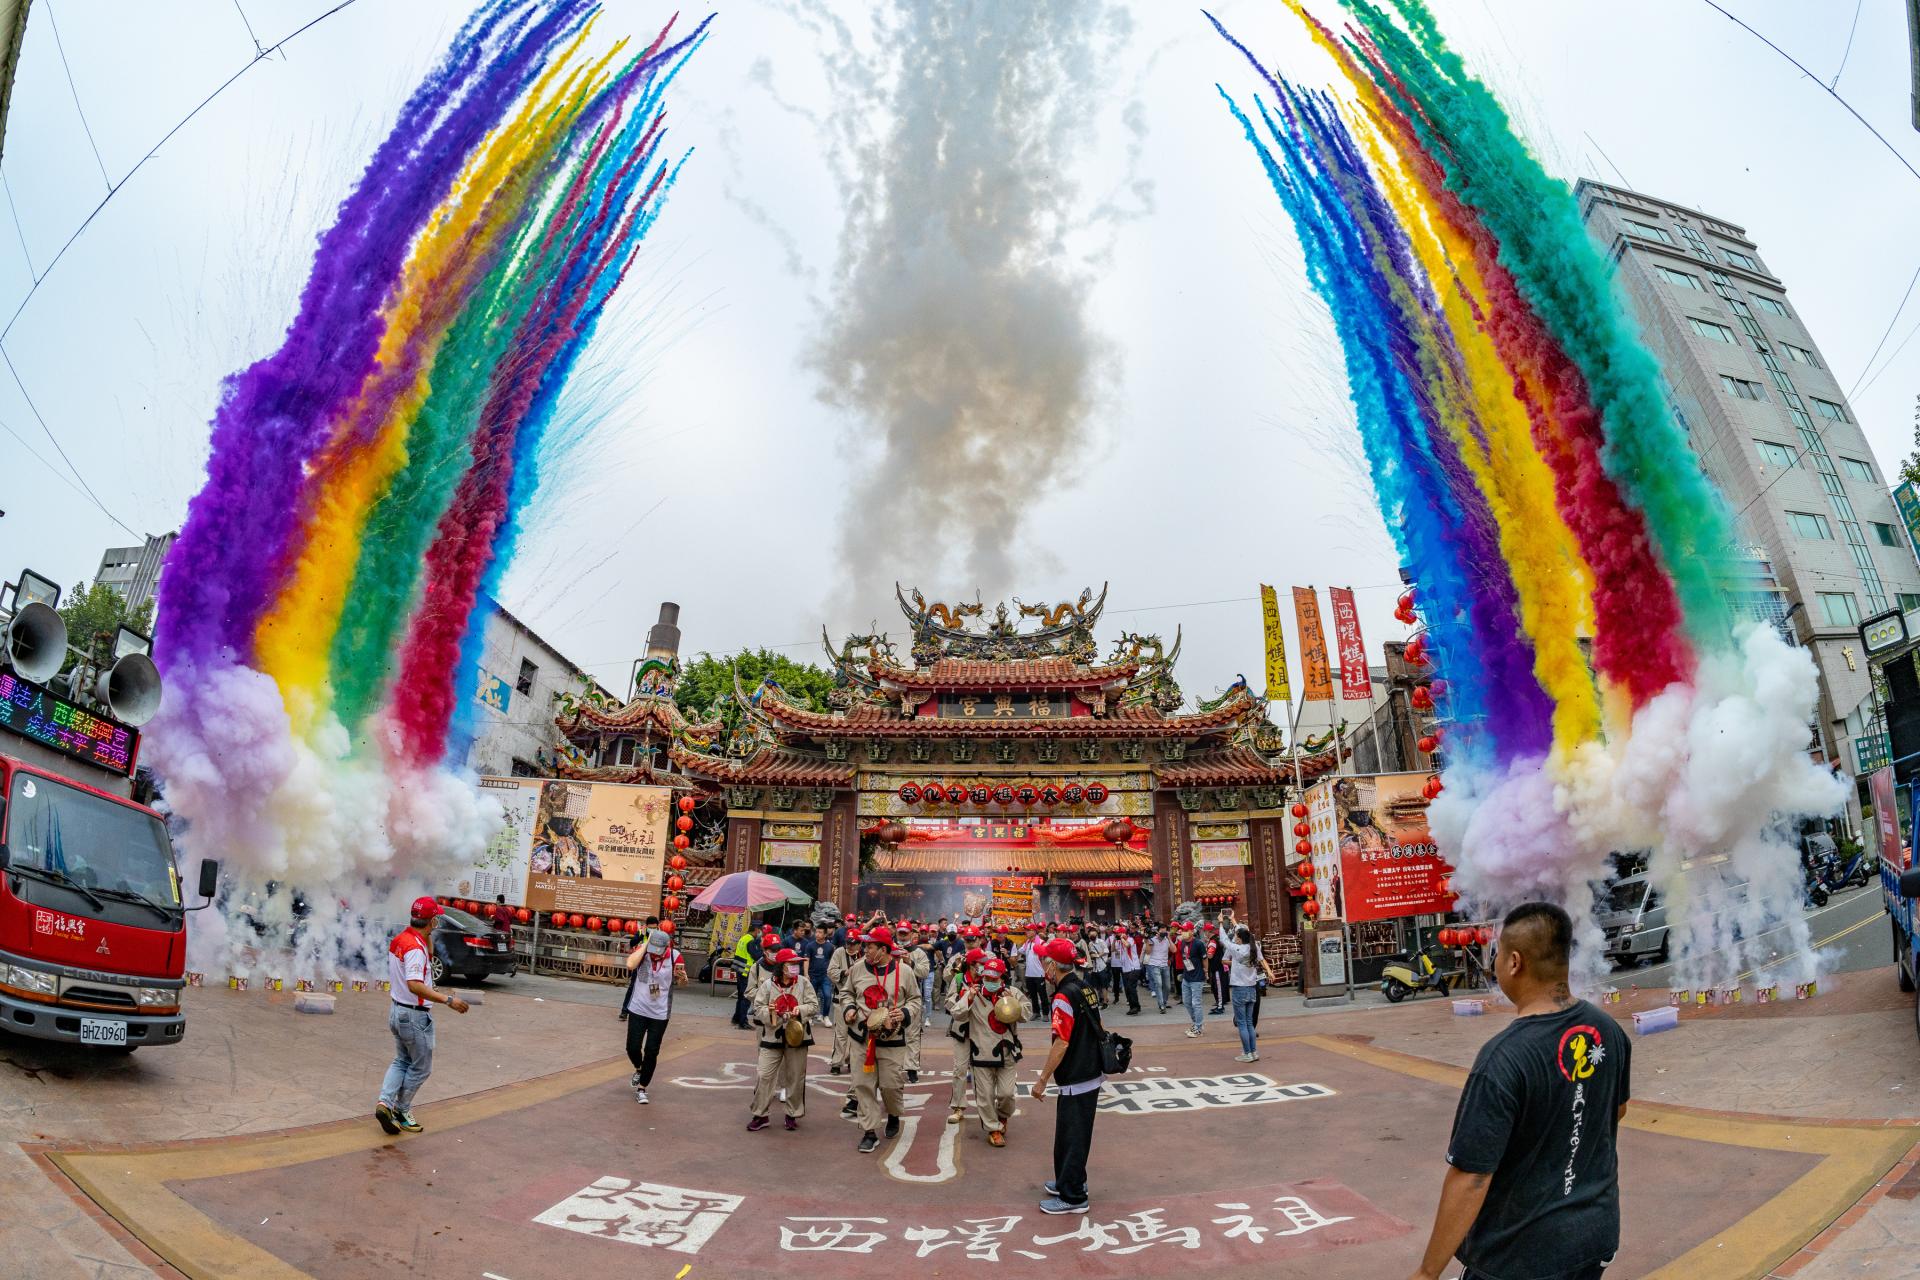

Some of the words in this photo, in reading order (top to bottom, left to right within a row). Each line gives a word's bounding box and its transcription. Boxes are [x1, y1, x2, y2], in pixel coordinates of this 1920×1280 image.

[1264, 601, 1289, 687] 西螺媽祖
[1302, 602, 1331, 688] 西螺媽祖
[1338, 602, 1369, 687] 西螺媽祖
[959, 695, 1051, 716] 福興宮
[901, 787, 1104, 802] 西螺太平媽祖文化祭
[54, 914, 86, 936] 福興宮
[82, 1024, 126, 1041] BHZ-0960
[780, 1197, 1356, 1262] 西螺媽祖
